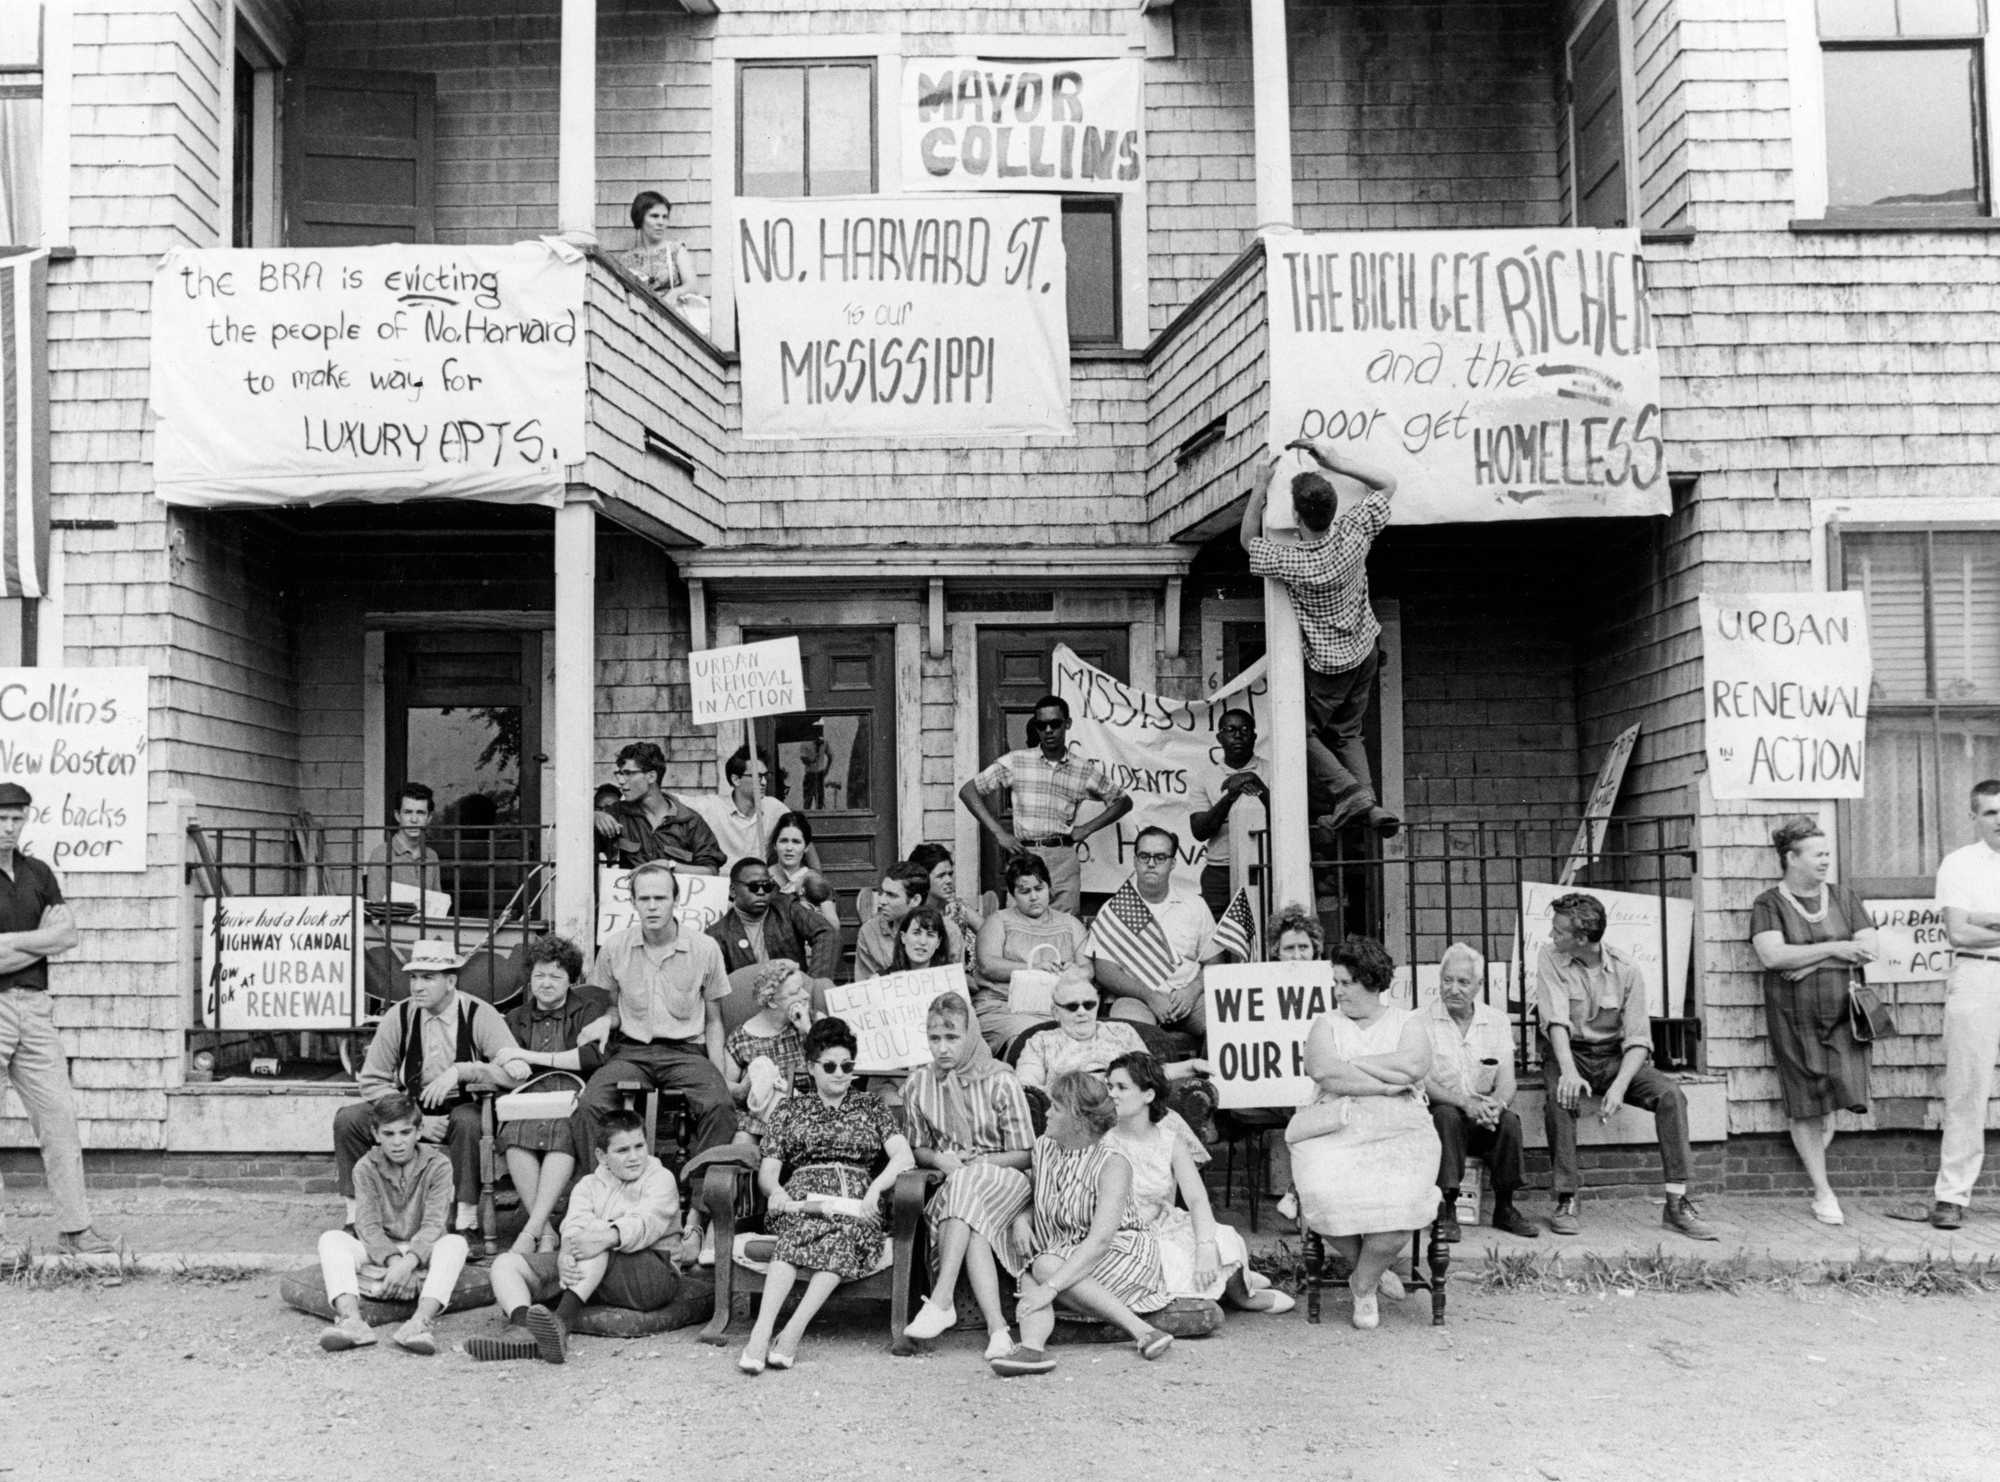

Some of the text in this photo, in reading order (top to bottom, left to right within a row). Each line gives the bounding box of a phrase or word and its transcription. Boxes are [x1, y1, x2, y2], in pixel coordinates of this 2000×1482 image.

[917, 69, 1084, 124] MAYOR
[920, 125, 1141, 182] COLLINS
[818, 216, 991, 287] HARVARD
[1005, 215, 1052, 293] ST.
[180, 260, 501, 310] the BRA is evicting
[1282, 251, 1344, 333] THE
[1429, 251, 1490, 334] GET
[206, 314, 257, 347] the
[271, 310, 360, 350] people
[377, 311, 408, 344] of
[464, 308, 577, 348] Harvard
[842, 300, 913, 326] is our
[243, 357, 484, 402] to make way for
[780, 336, 995, 405] MISSISSIPPI
[1366, 340, 1533, 390] and the
[304, 414, 559, 468] LUXURY APTS.
[1300, 400, 1665, 491] poor get HOMELESS
[1718, 610, 1849, 646] URBAN
[695, 652, 759, 678] URBAN
[711, 669, 793, 694] REMOVAL
[1208, 671, 1218, 690] 6
[0, 682, 118, 725] Collins
[699, 688, 793, 714] IN ACTION
[1712, 679, 1867, 719] RENEWAL
[1719, 735, 1863, 785] IN ACTION
[61, 792, 127, 829] backs
[53, 839, 123, 868] poor
[255, 908, 286, 928] had
[283, 914, 295, 928] a
[296, 906, 327, 927] look
[329, 909, 351, 927] at
[290, 932, 351, 951] SCANDAL
[262, 960, 344, 985] URBAN
[830, 969, 961, 1013] LET PEOPLE
[247, 990, 352, 1017] RENEWAL
[1214, 987, 1265, 1022] WE
[1218, 1040, 1282, 1081] OUR
